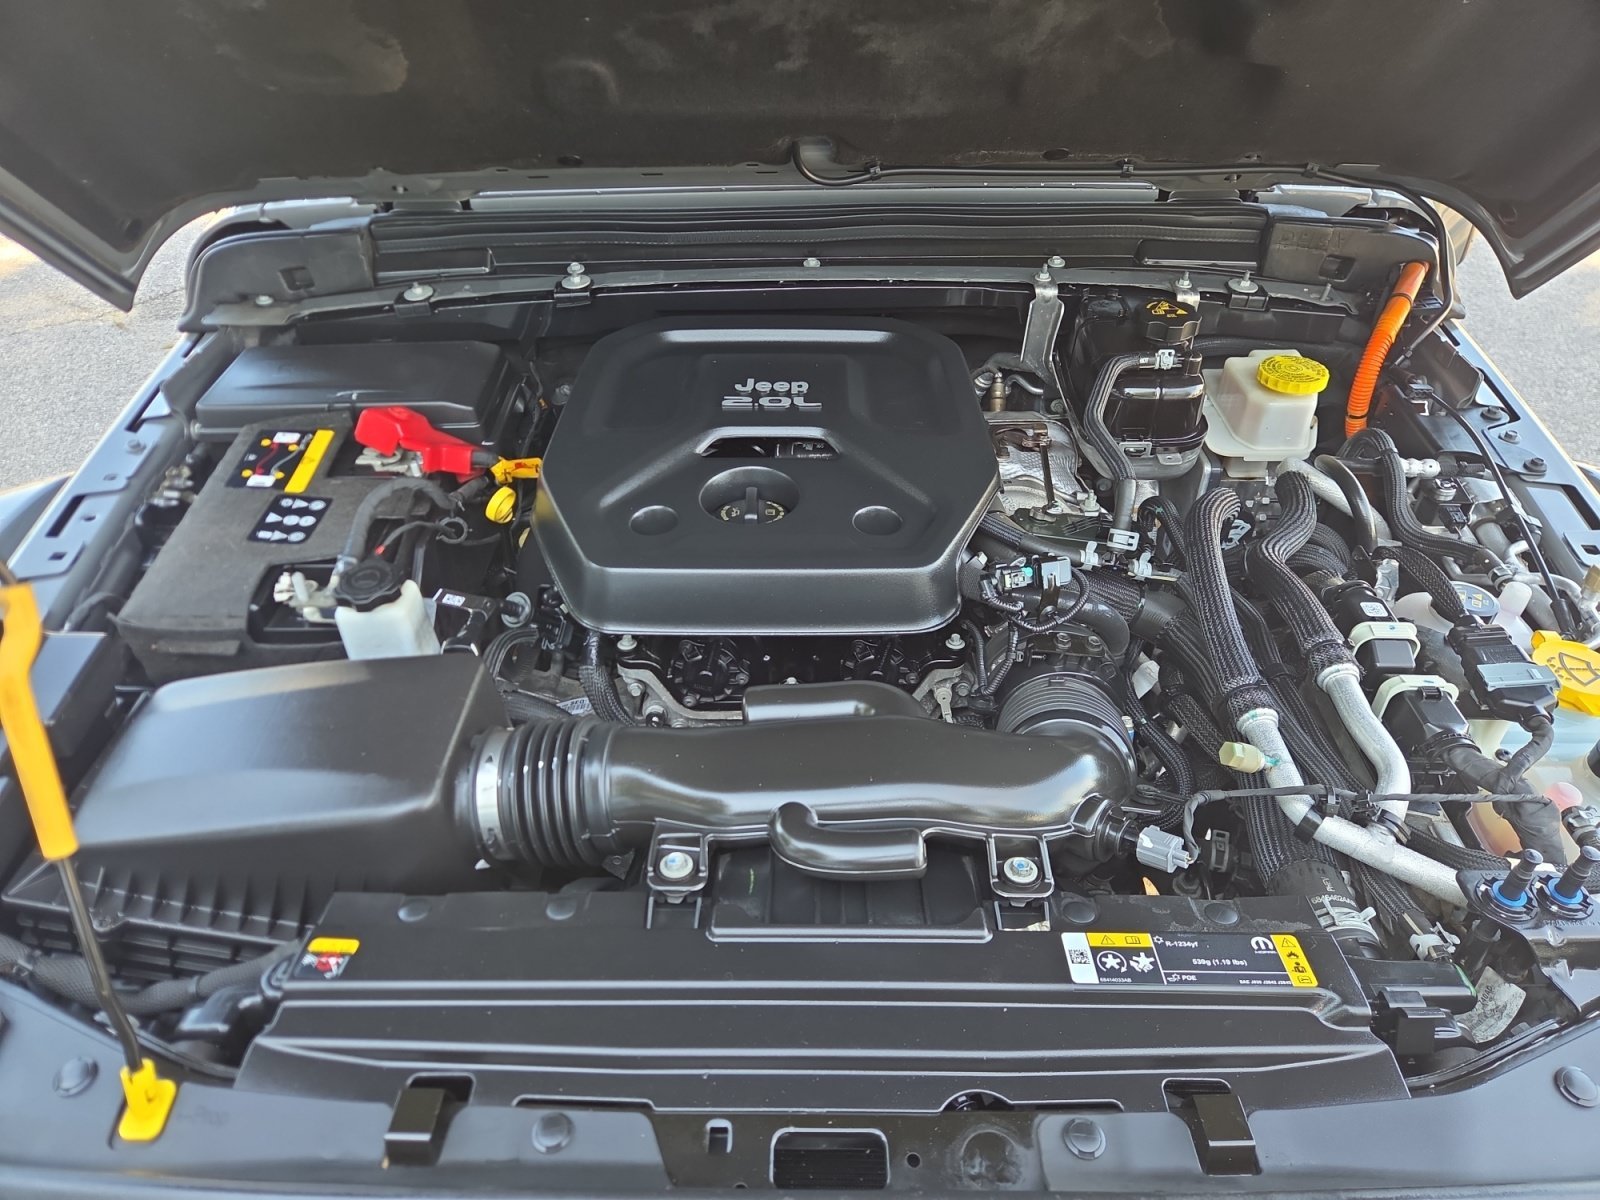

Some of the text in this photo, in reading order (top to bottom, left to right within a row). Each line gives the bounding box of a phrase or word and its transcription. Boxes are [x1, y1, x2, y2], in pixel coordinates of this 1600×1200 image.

[734, 378, 809, 394] Jeep
[721, 396, 822, 409] 2.0L
[1165, 940, 1198, 949] R-1234yf
[1231, 958, 1248, 967] lbs)
